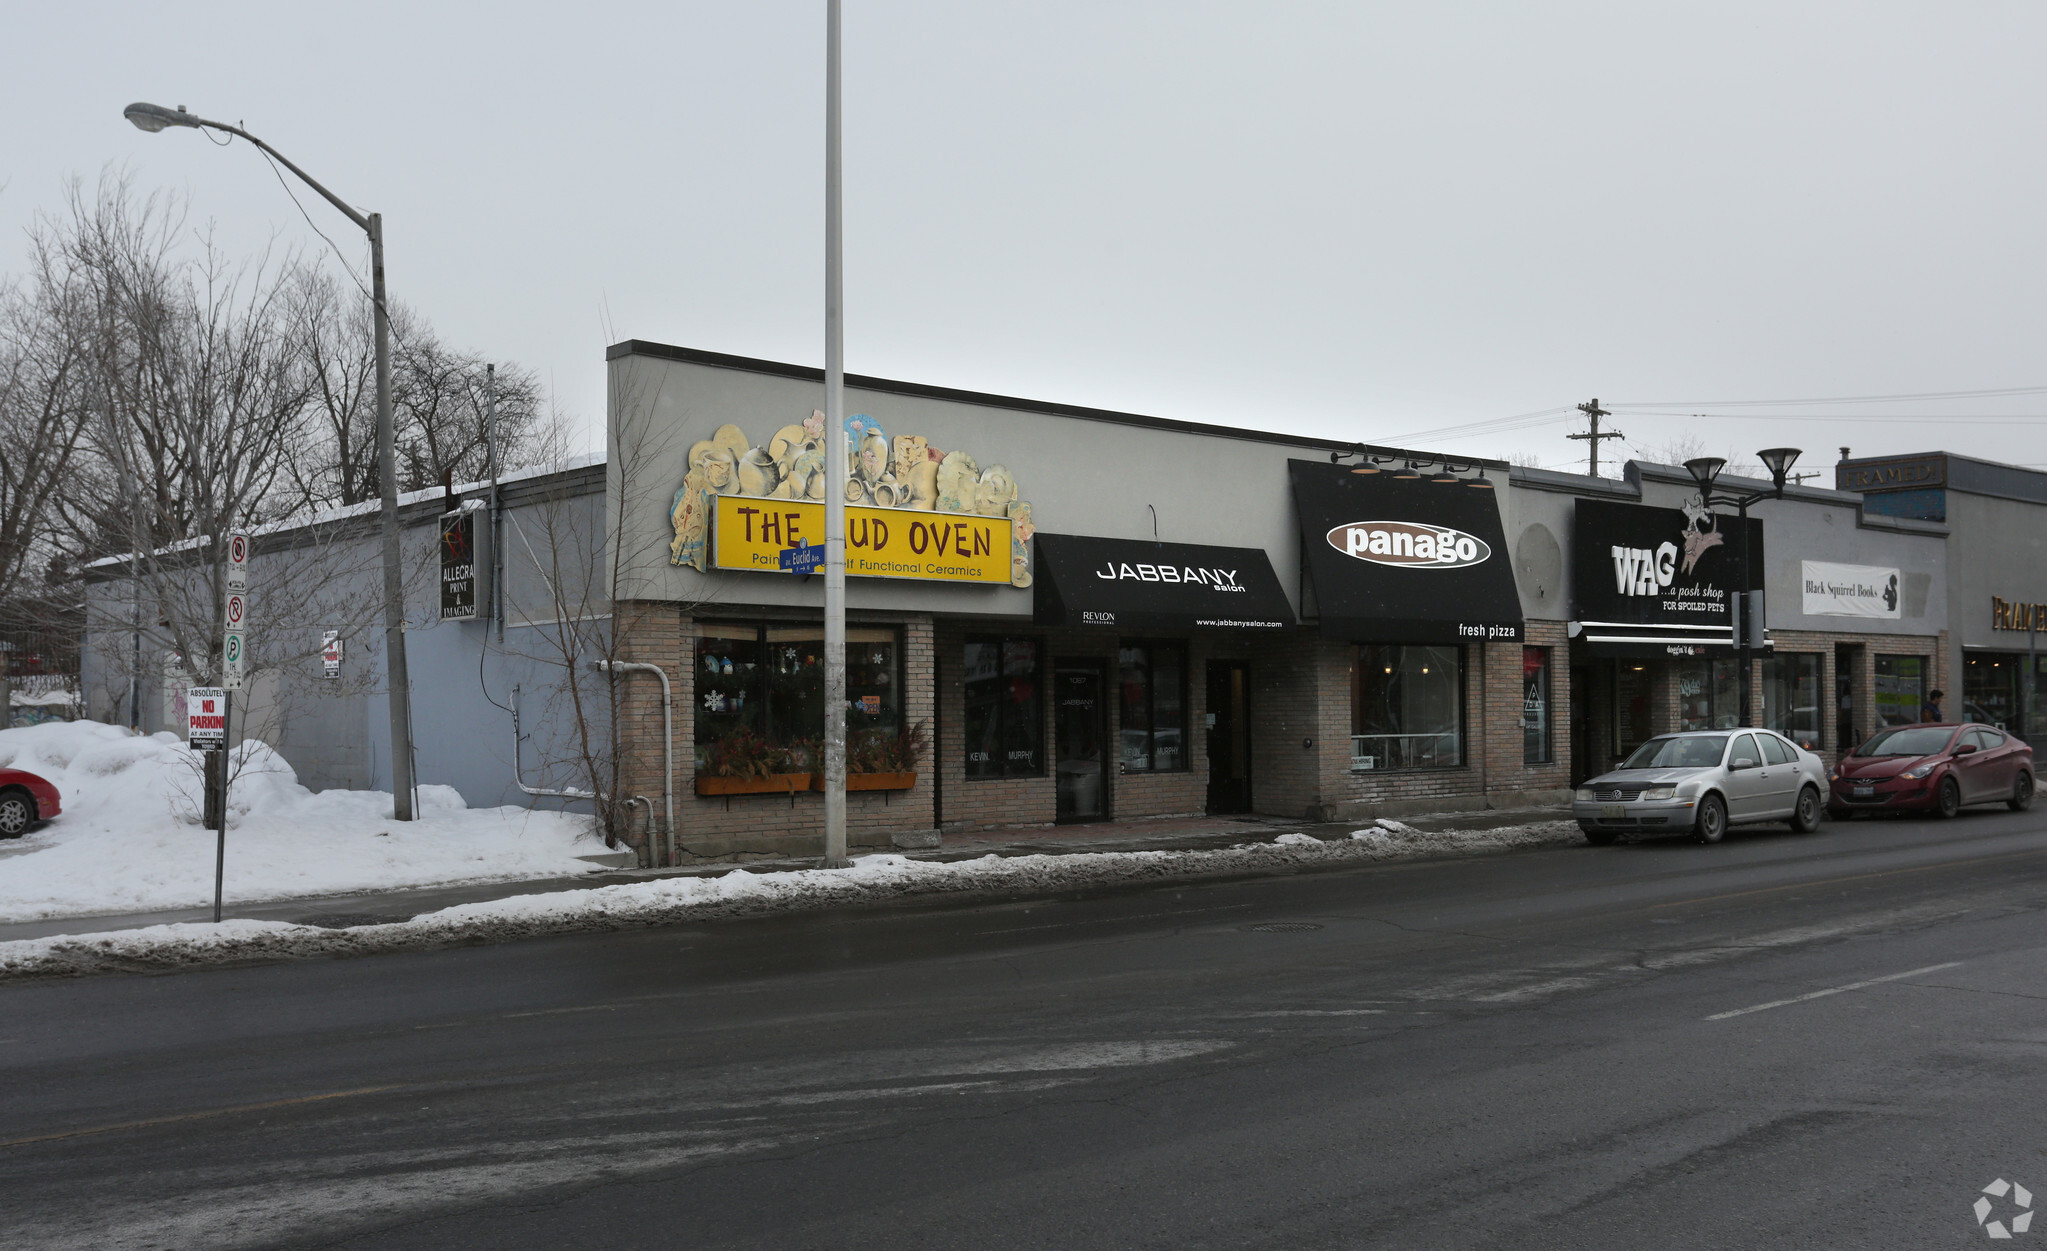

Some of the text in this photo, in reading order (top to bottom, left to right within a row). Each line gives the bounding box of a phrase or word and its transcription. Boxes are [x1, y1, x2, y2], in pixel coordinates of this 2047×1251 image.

[737, 507, 990, 558] THE UD OVEN
[1347, 527, 1477, 563] panago
[792, 550, 811, 565] Euclid
[443, 564, 475, 582] ALLEGRA
[859, 560, 921, 573] Functional
[926, 564, 982, 576] Ceramics
[1096, 562, 1237, 586] JABBANY
[1611, 541, 1678, 597] WAG
[450, 582, 467, 593] PRINT
[1213, 584, 1246, 592] salon
[1678, 582, 1700, 600] posh
[1702, 583, 1725, 602] shop
[1806, 580, 1878, 599] Black Squirrel Books
[456, 594, 461, 606] &
[1663, 601, 1725, 612] FOR SPOILED PETS
[444, 605, 475, 617] IMAGING
[1083, 611, 1115, 622] REVLON
[1992, 596, 2047, 631] FRAME
[1196, 619, 1283, 628] www.jabbanysalon.com
[1459, 623, 1515, 640] fresh pizza
[202, 700, 215, 713] NO
[1008, 751, 1034, 760] MURPHY
[1157, 747, 1179, 755] MURPHY
